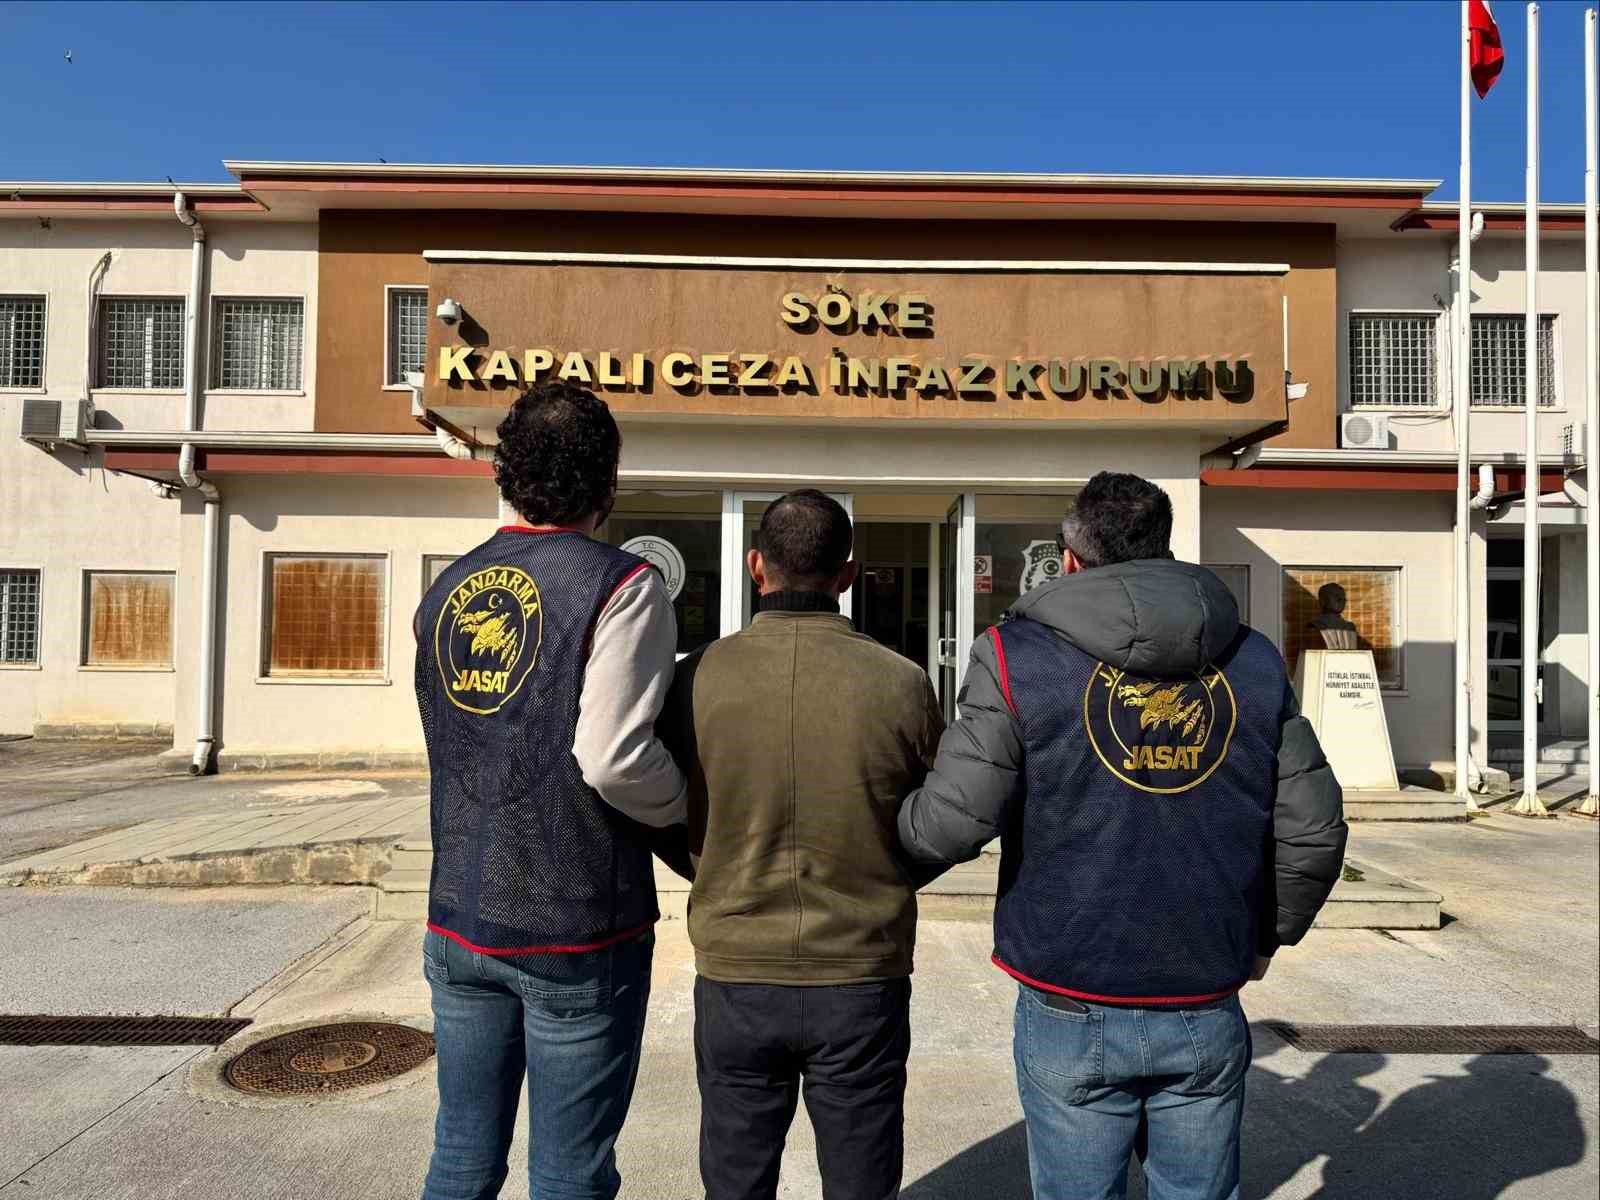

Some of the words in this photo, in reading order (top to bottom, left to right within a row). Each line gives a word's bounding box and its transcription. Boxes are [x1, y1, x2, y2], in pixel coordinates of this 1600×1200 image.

[780, 283, 929, 329] SÖKE
[438, 346, 645, 387] KAPALI
[660, 351, 811, 387] CEZA
[829, 347, 991, 393] İNFAZ
[1004, 359, 1249, 394] KURUMU
[641, 542, 657, 550] T.C.
[449, 570, 538, 619] JANDARMA
[452, 669, 510, 693] JASAT
[1123, 745, 1203, 770] JASAT
